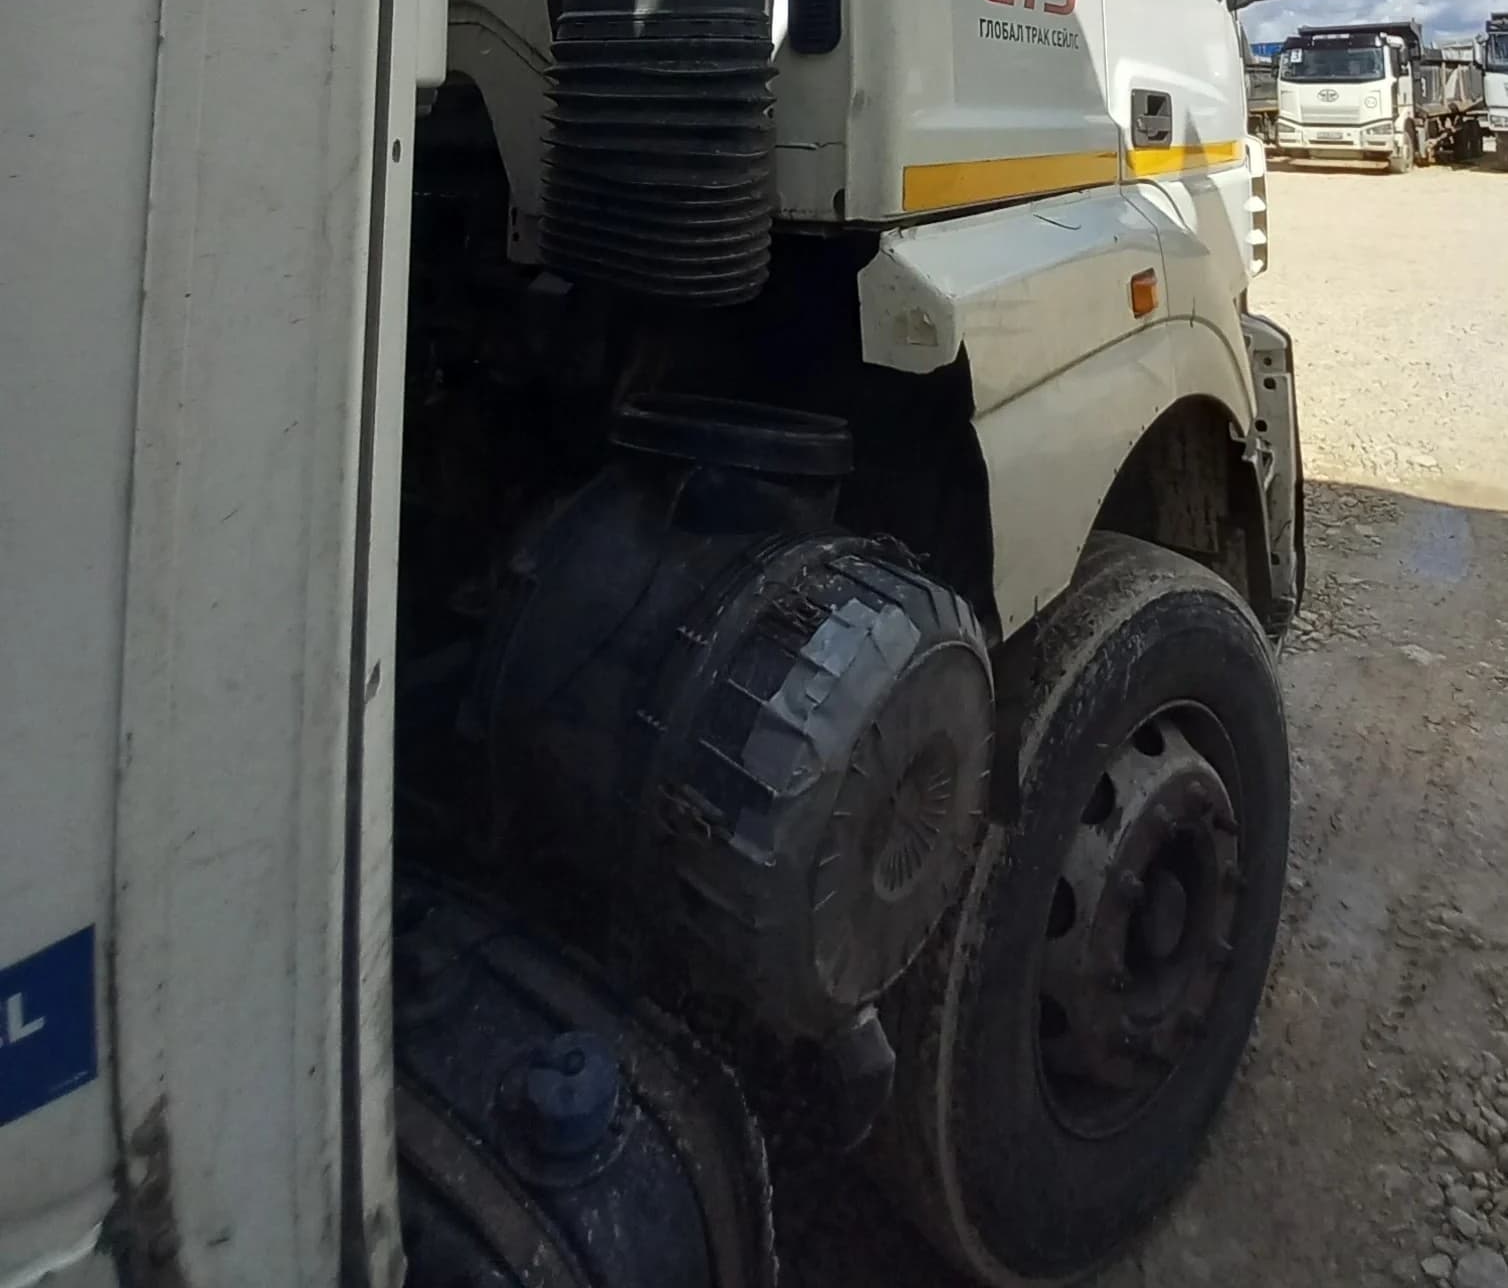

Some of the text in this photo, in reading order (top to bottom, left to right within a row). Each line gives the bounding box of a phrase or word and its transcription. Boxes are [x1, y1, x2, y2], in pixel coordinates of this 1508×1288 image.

[979, 18, 1079, 50] ГЛОБАЛ ТРАК СЕЙЛС
